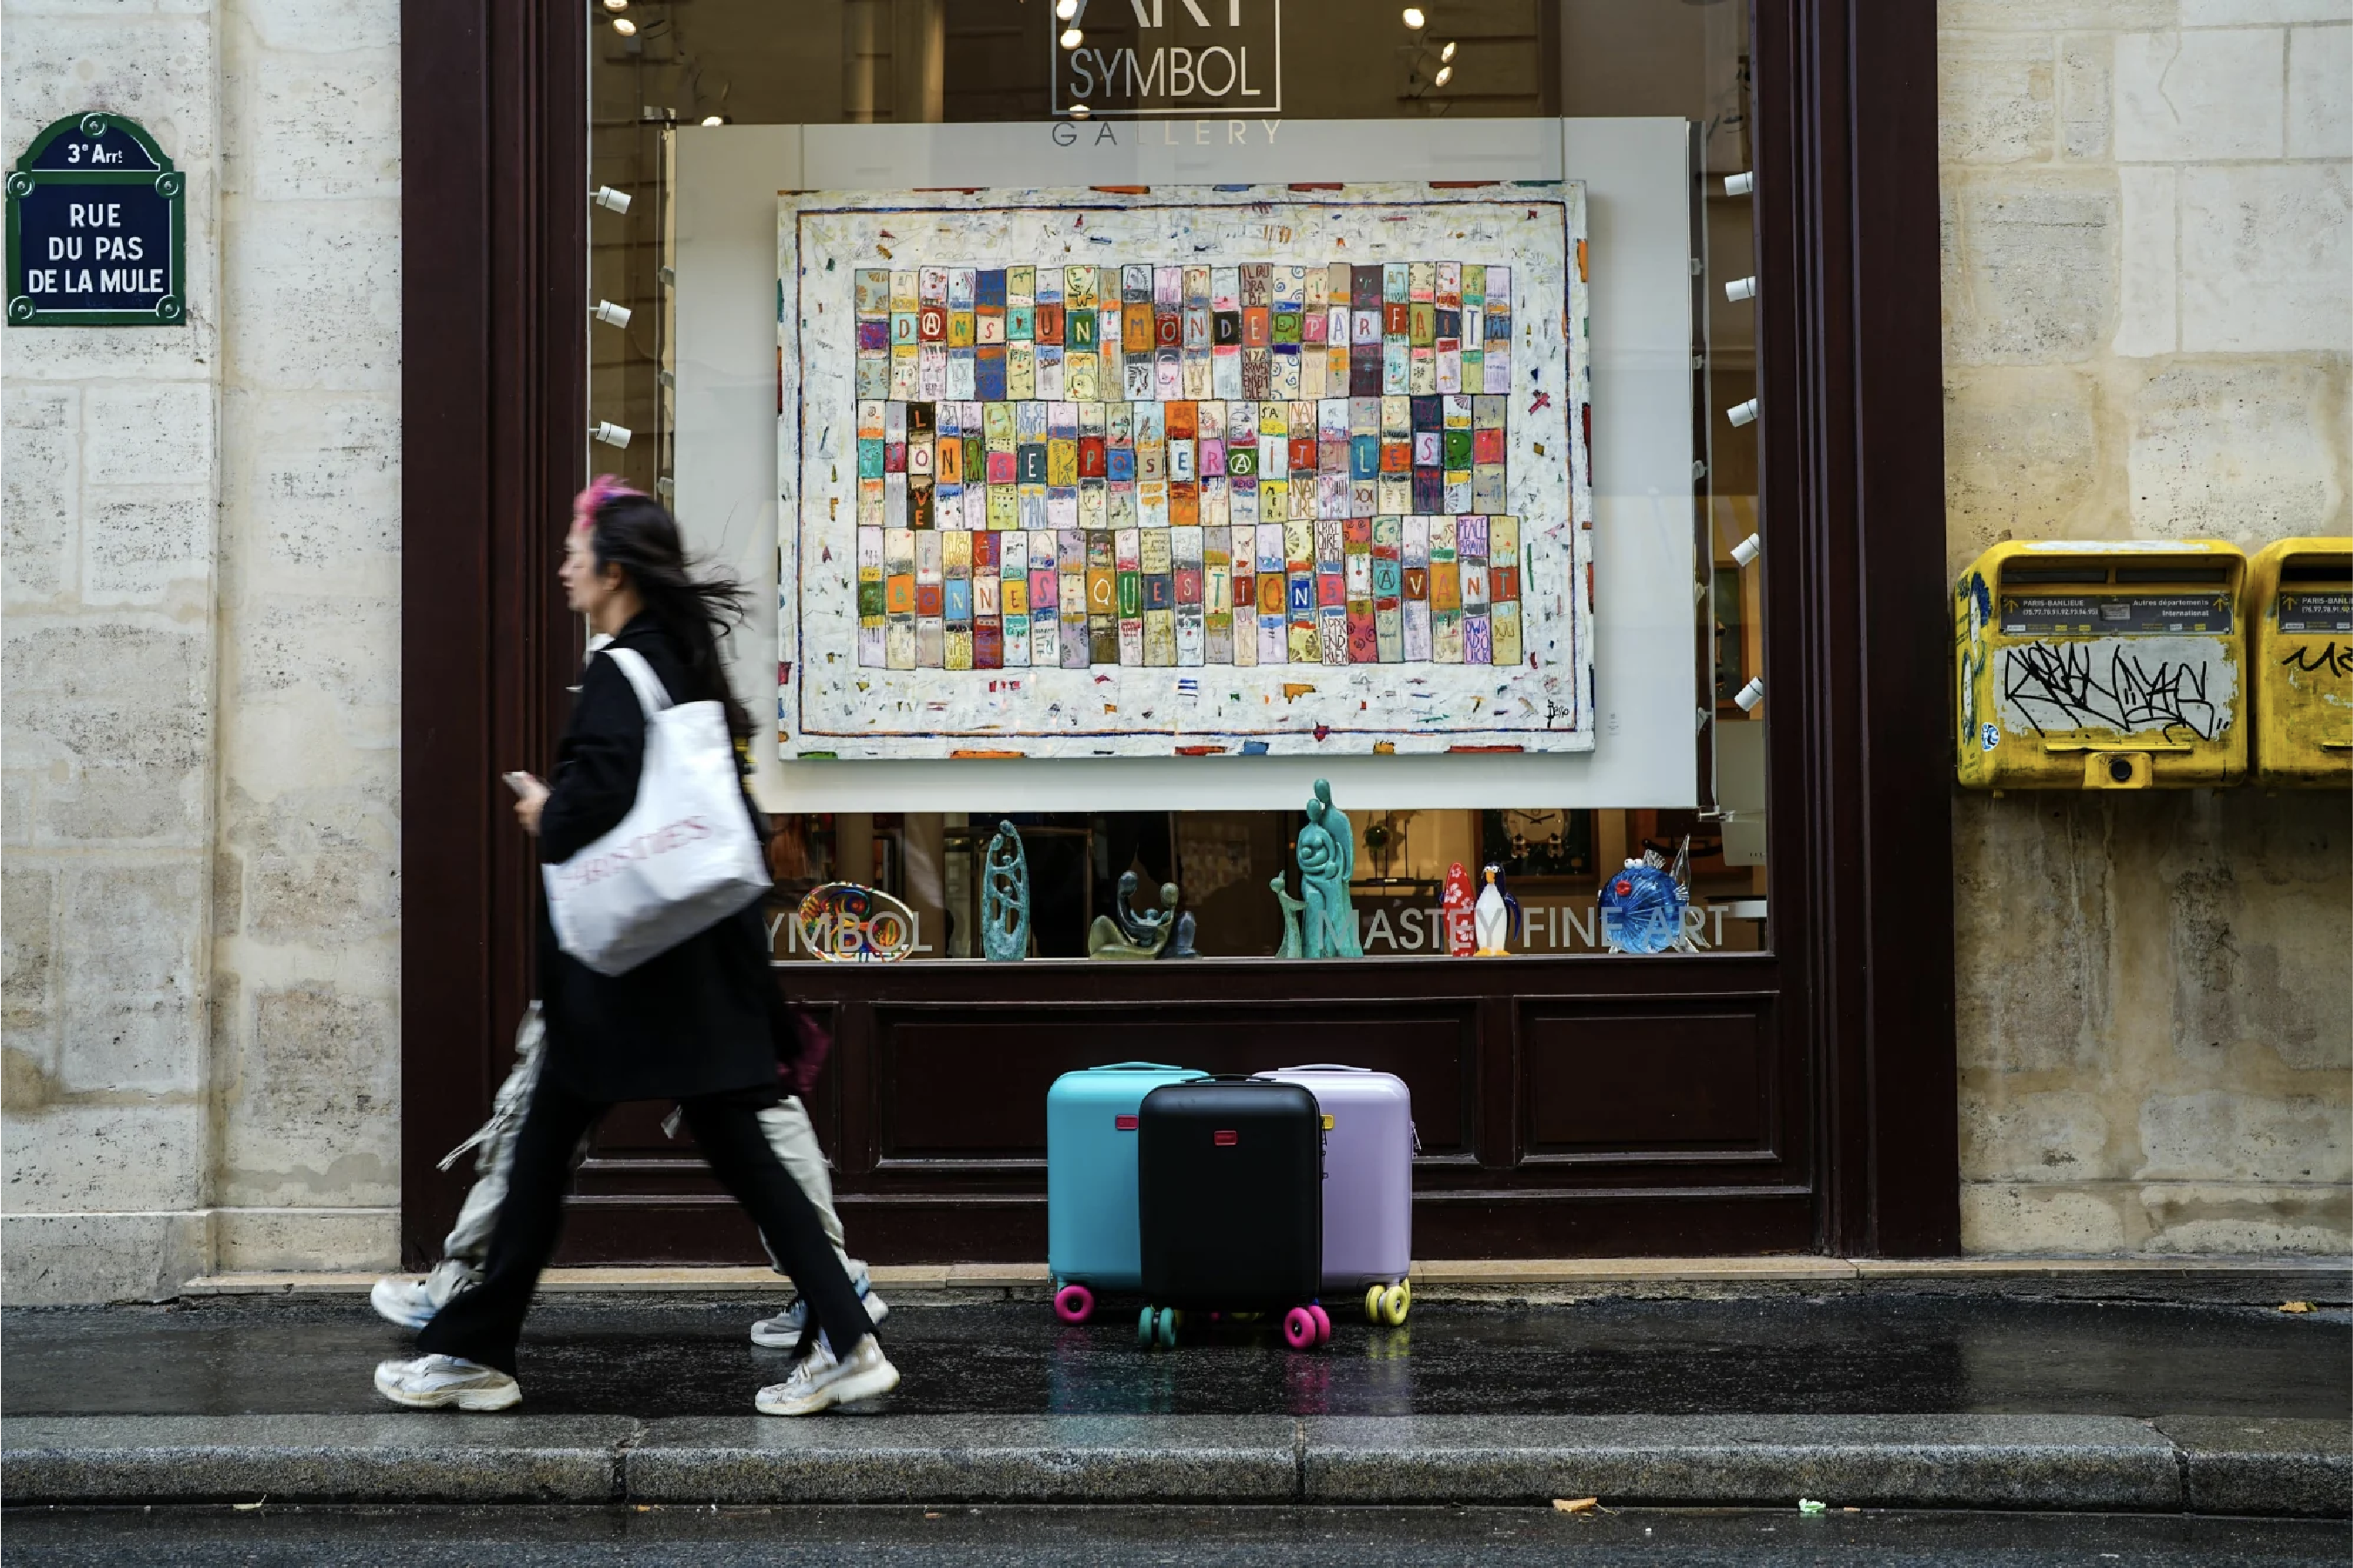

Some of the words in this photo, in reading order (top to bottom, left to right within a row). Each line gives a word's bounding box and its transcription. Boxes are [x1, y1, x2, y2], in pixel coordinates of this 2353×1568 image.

[1070, 46, 1261, 98] SYMBOL
[70, 203, 121, 227] RUE
[49, 236, 83, 260] DU
[95, 236, 144, 260] PAS
[29, 268, 58, 293] DE
[65, 268, 93, 293] LA
[99, 268, 164, 293] MULE
[1131, 315, 1261, 341] MONDE
[1359, 437, 1434, 473] LES
[895, 585, 1051, 609] BONNES
[761, 910, 933, 953] YMBOL
[1317, 908, 1505, 950] MASTEY
[1523, 906, 1624, 949] FINE
[1643, 904, 1730, 948] ART
